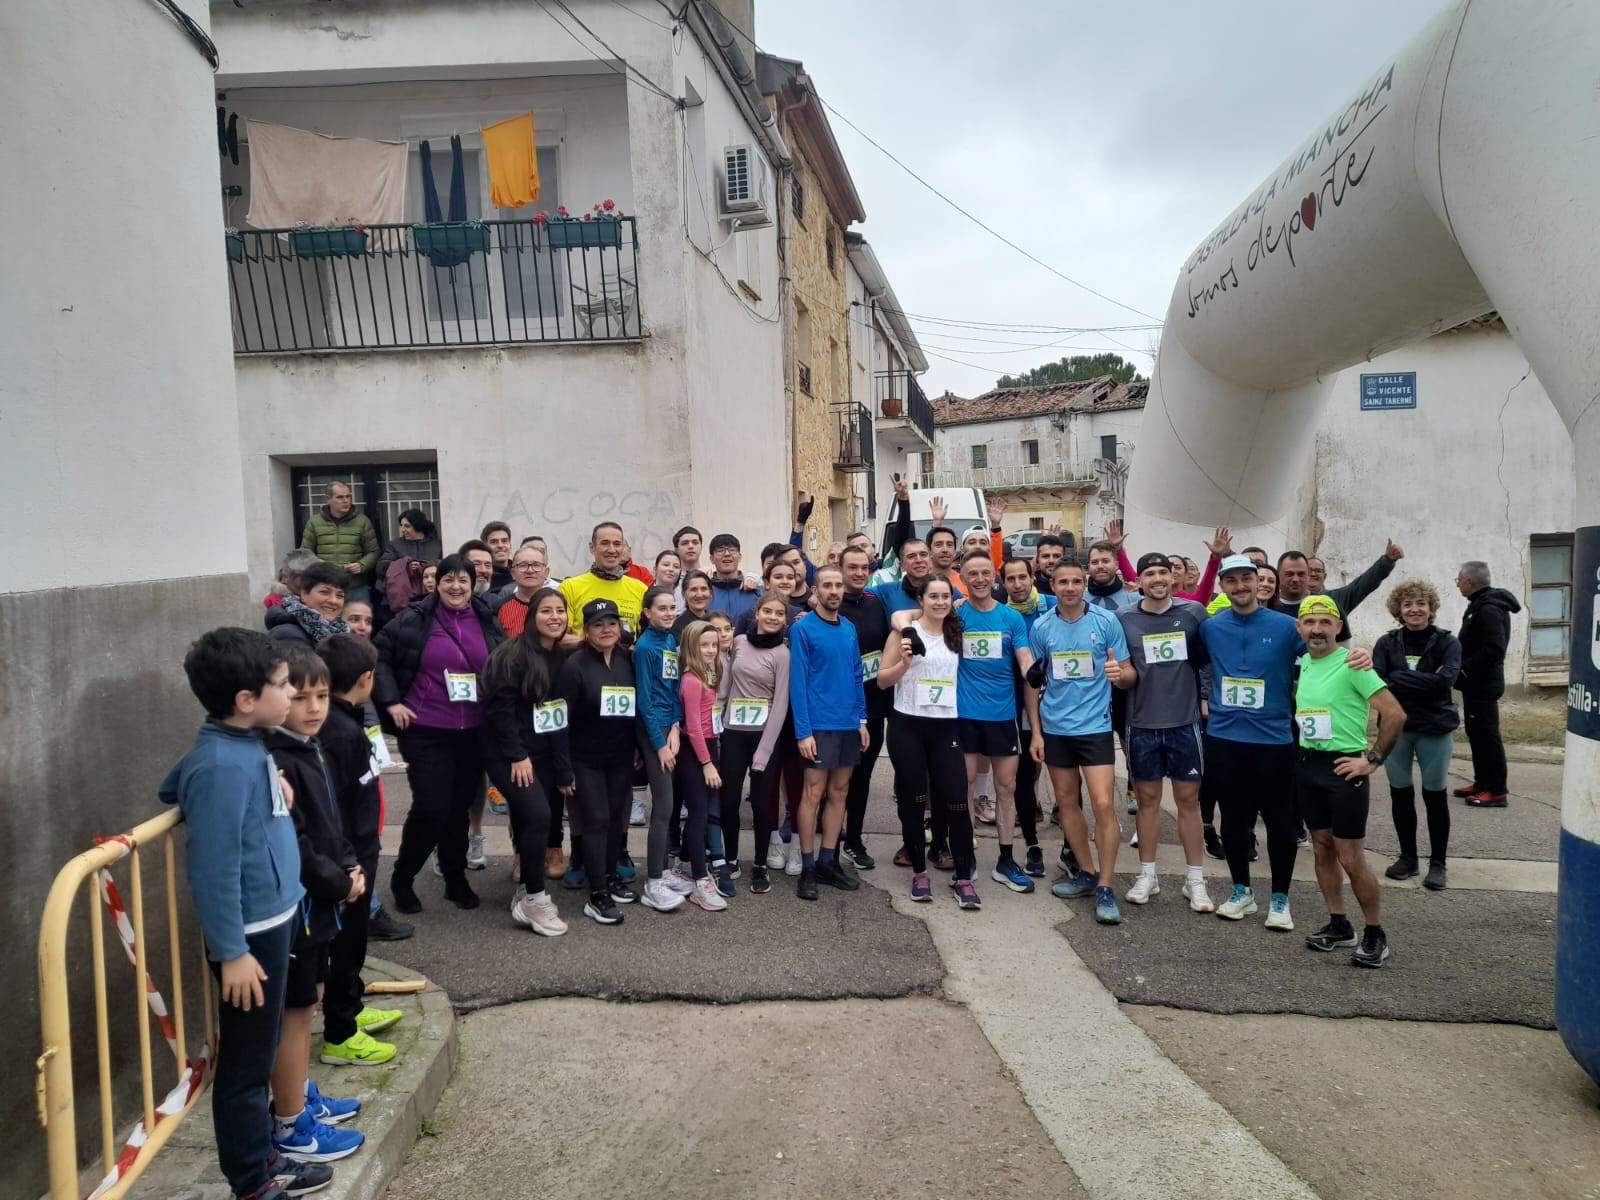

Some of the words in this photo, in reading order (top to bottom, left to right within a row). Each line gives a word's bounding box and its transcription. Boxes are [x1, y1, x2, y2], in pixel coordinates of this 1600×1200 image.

[1282, 63, 1395, 190] MANCHA
[596, 602, 607, 610] NY
[976, 638, 989, 657] 8
[1160, 640, 1175, 660] 6
[1066, 658, 1081, 677] 2
[607, 694, 630, 714] 19
[930, 685, 944, 704] 7
[1227, 685, 1257, 706] 13
[539, 707, 564, 730] 20
[737, 705, 762, 724] 17
[1303, 716, 1317, 738] 3
